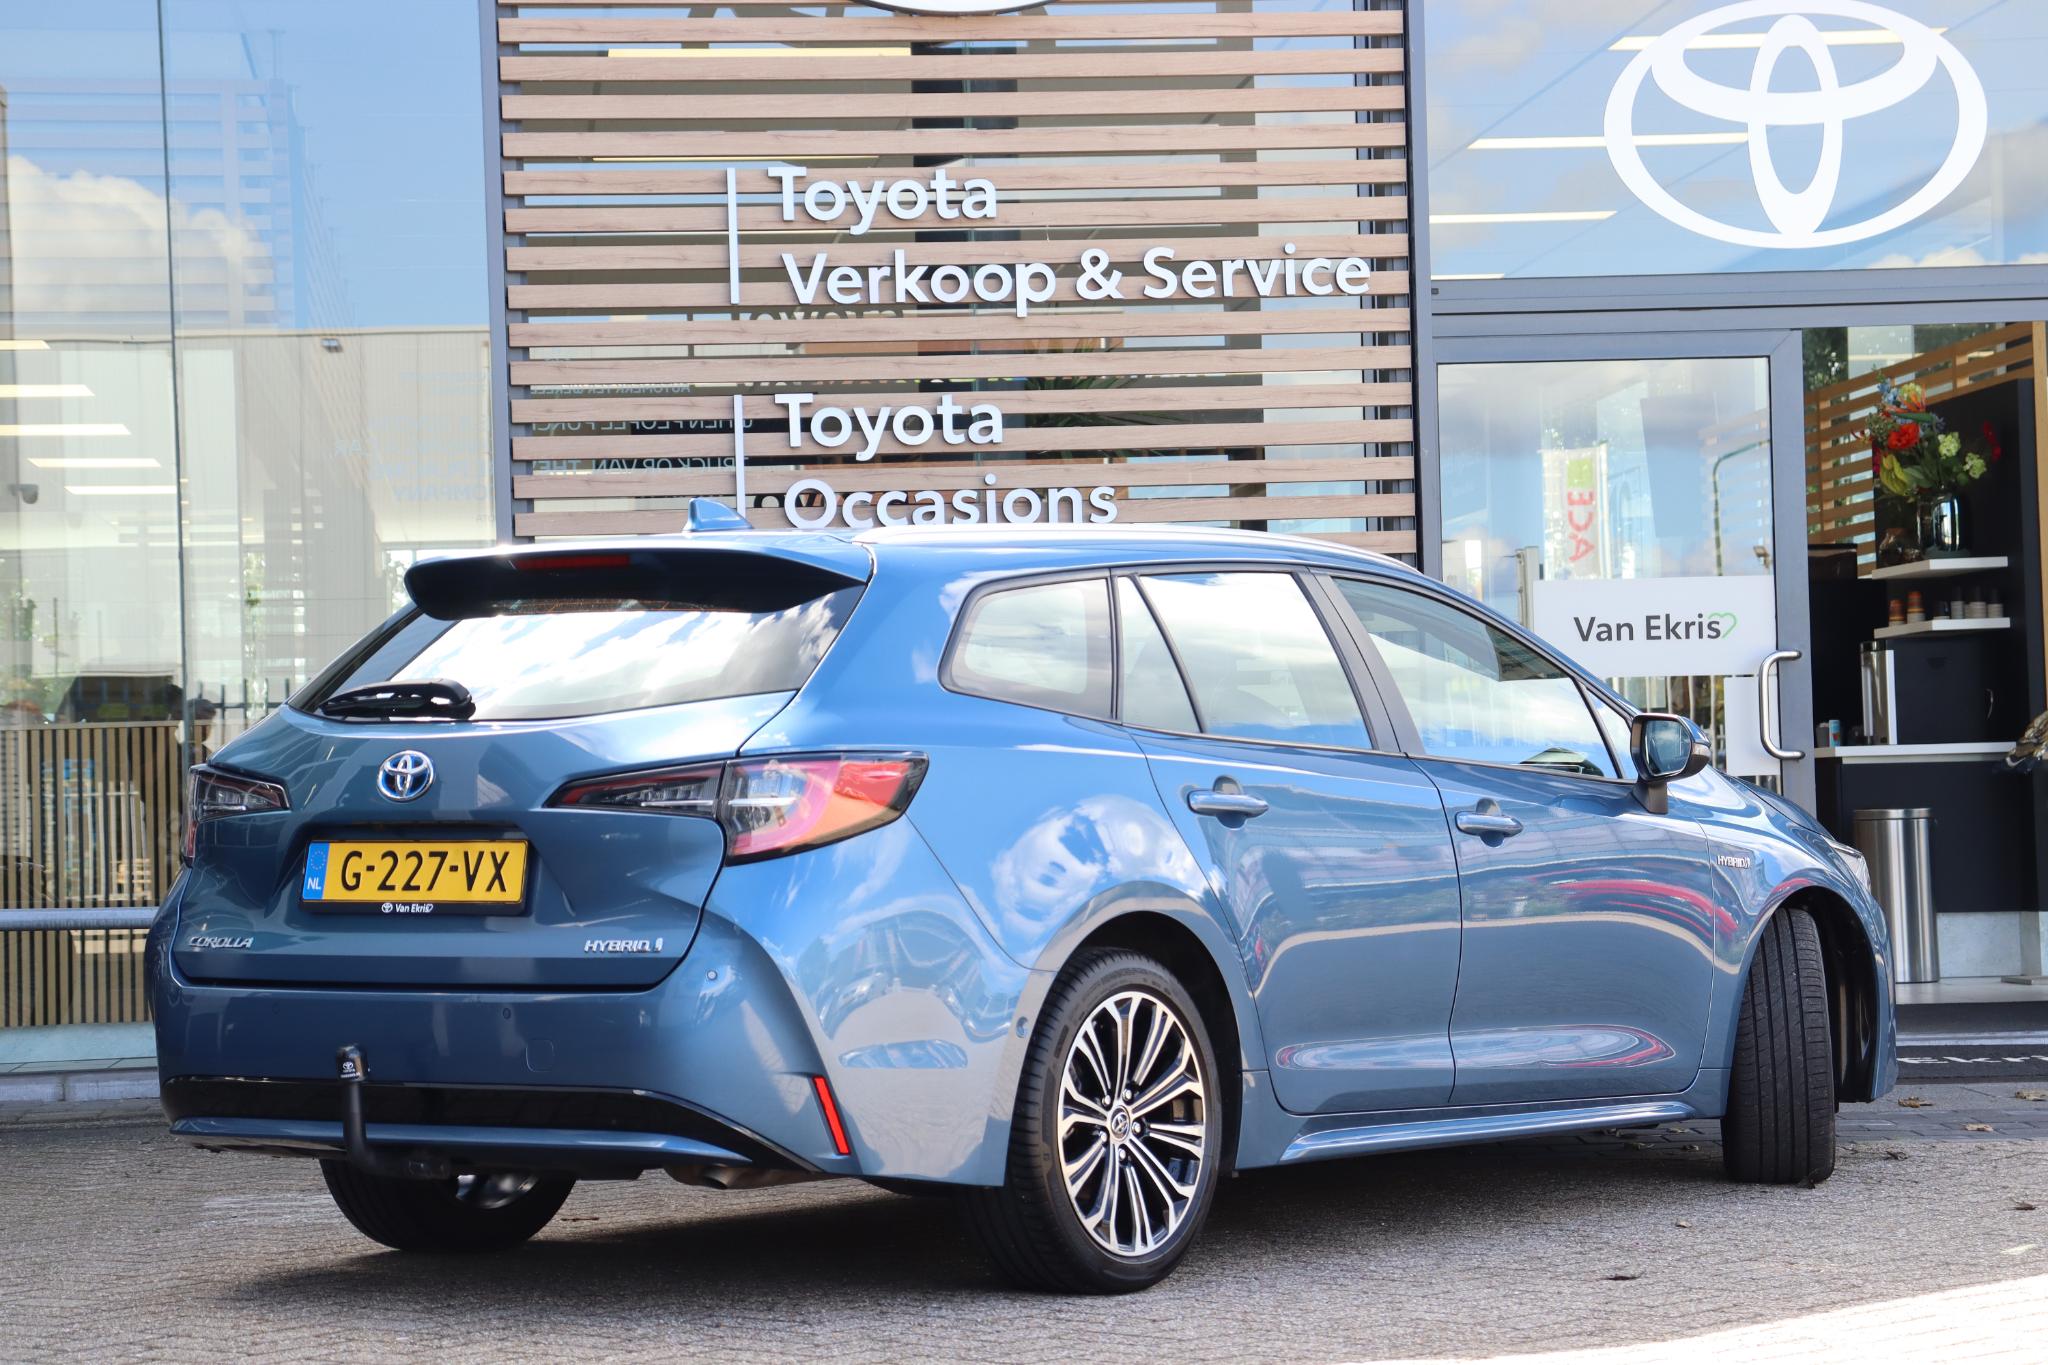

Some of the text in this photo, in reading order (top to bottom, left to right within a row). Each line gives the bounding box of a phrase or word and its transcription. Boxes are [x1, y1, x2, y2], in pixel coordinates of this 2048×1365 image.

[768, 166, 998, 236] Toyota
[781, 242, 1371, 318] Verkoop & Service
[774, 392, 1004, 462] Toyota
[783, 472, 1118, 529] Occasions
[1573, 613, 1722, 642] Van Ekris
[306, 850, 510, 893] NL G-227-VX
[1717, 855, 1745, 868] HYBRID
[395, 903, 430, 913] Van Ekris
[188, 936, 254, 948] COROLLA
[584, 939, 651, 952] HYBRID
